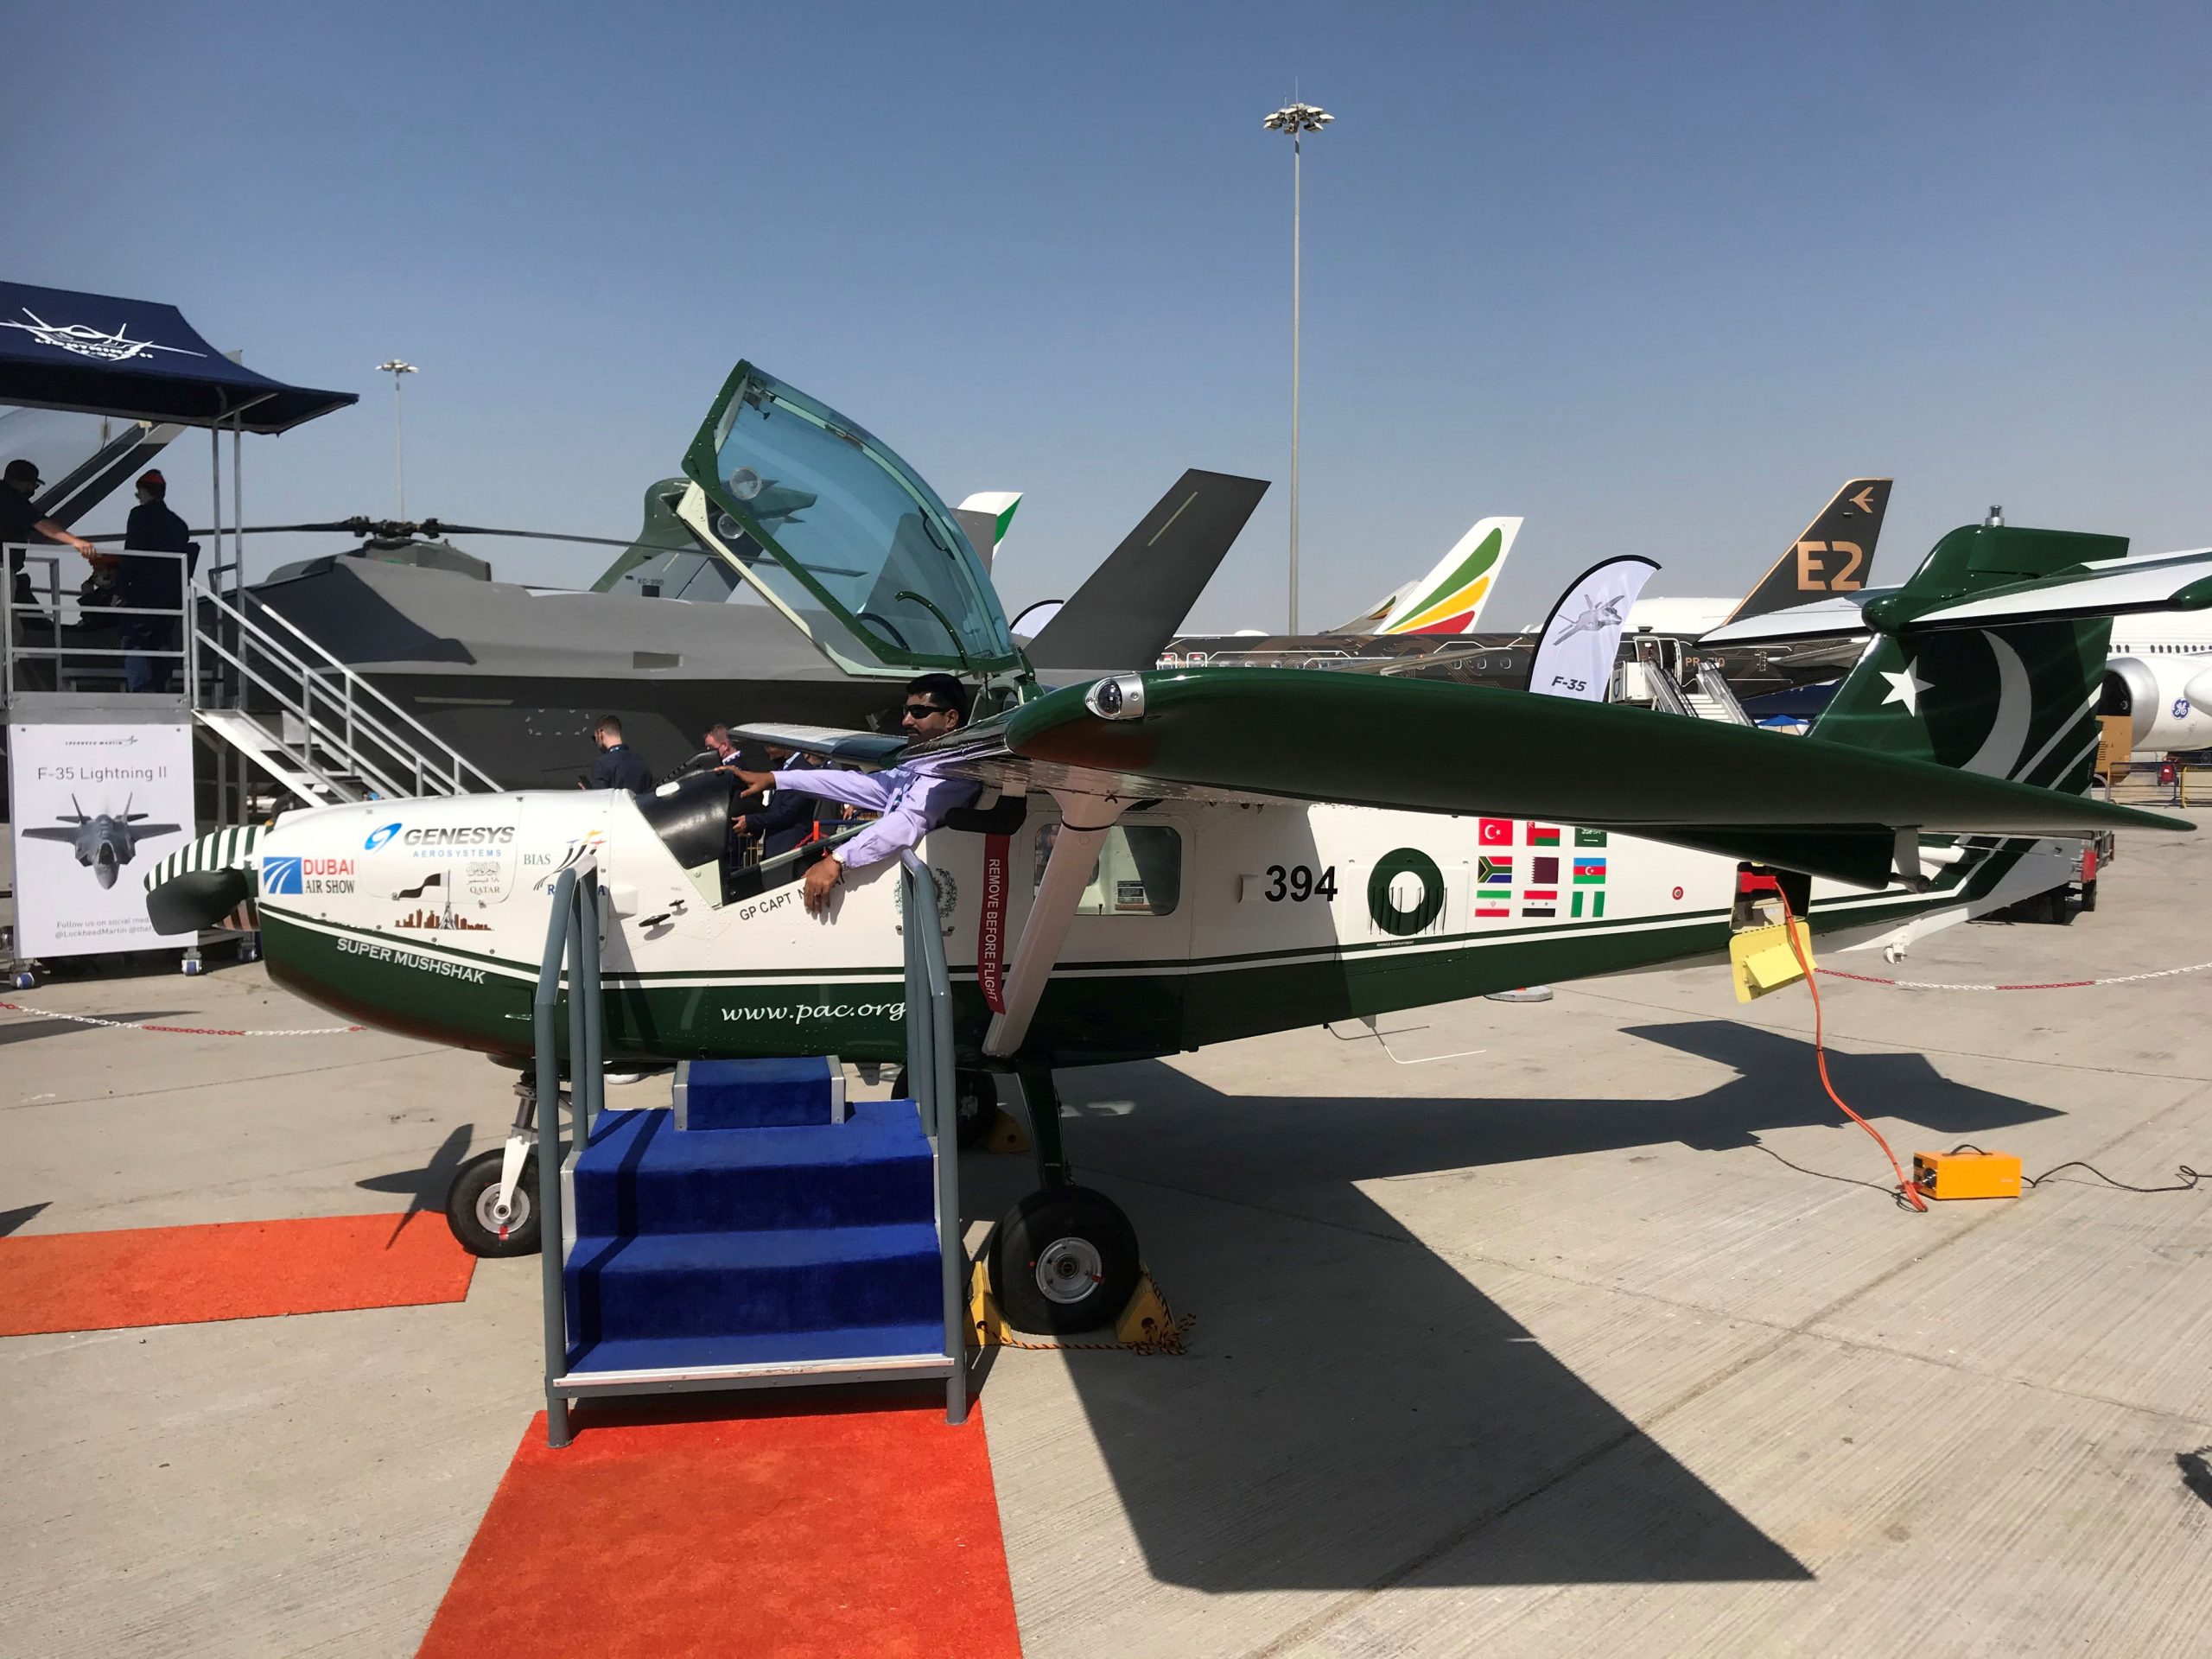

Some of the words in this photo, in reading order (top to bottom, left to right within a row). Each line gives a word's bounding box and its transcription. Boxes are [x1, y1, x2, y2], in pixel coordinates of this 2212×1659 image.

[1797, 541, 1862, 591] E2
[1551, 676, 1587, 692] F-35
[38, 766, 74, 780] F-35
[80, 766, 153, 783] Lightning
[404, 826, 515, 846] GENESYS
[413, 849, 501, 858] AEROSYSTEMS
[524, 854, 550, 865] BIAS
[303, 859, 354, 875] DUBAI
[305, 880, 323, 893] AIR
[326, 880, 355, 893] SHOW
[469, 887, 500, 895] QATAR
[987, 859, 1001, 909] REMOVE
[1264, 865, 1338, 902] 394
[740, 906, 757, 920] GP
[760, 893, 792, 914] CAPT
[55, 928, 127, 939] @LockheedMartin
[984, 912, 997, 959] BEFORE
[337, 938, 391, 962] SUPER
[394, 951, 486, 984] MUSHSHAK
[984, 963, 997, 1001] FLIGHT
[721, 1001, 906, 1025] www.pac.org
